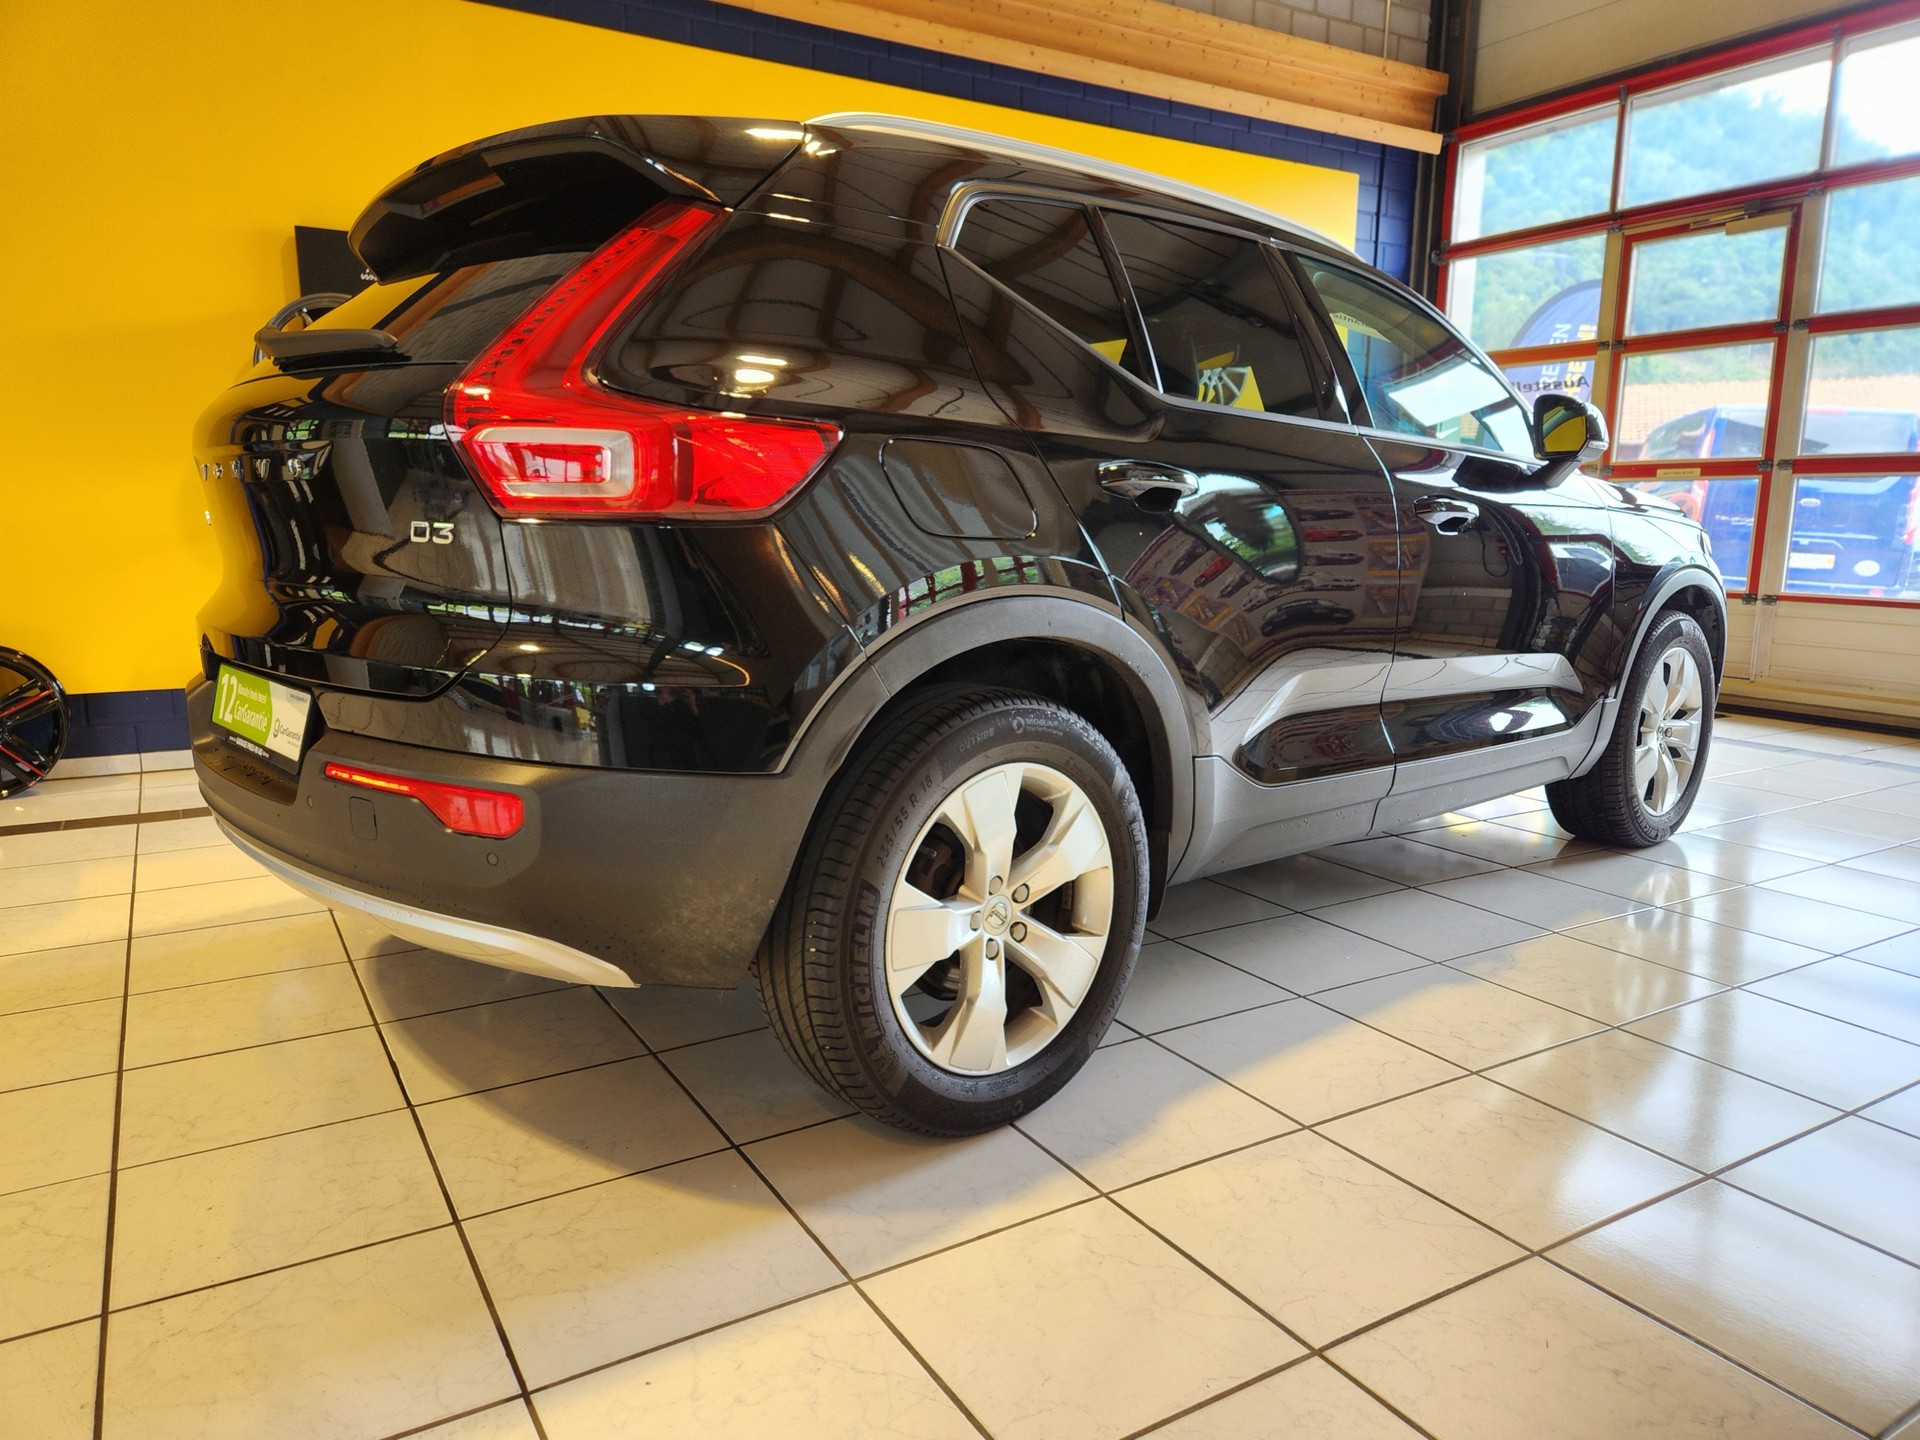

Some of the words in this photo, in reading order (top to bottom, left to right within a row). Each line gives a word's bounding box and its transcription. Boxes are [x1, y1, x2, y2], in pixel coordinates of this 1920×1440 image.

[411, 521, 455, 545] D3
[219, 673, 238, 723] 12
[959, 728, 995, 752] OUTSIDE
[876, 807, 909, 868] 235/55
[909, 793, 920, 808] R
[920, 775, 933, 792] 18
[853, 887, 882, 1040] MICHELIN
